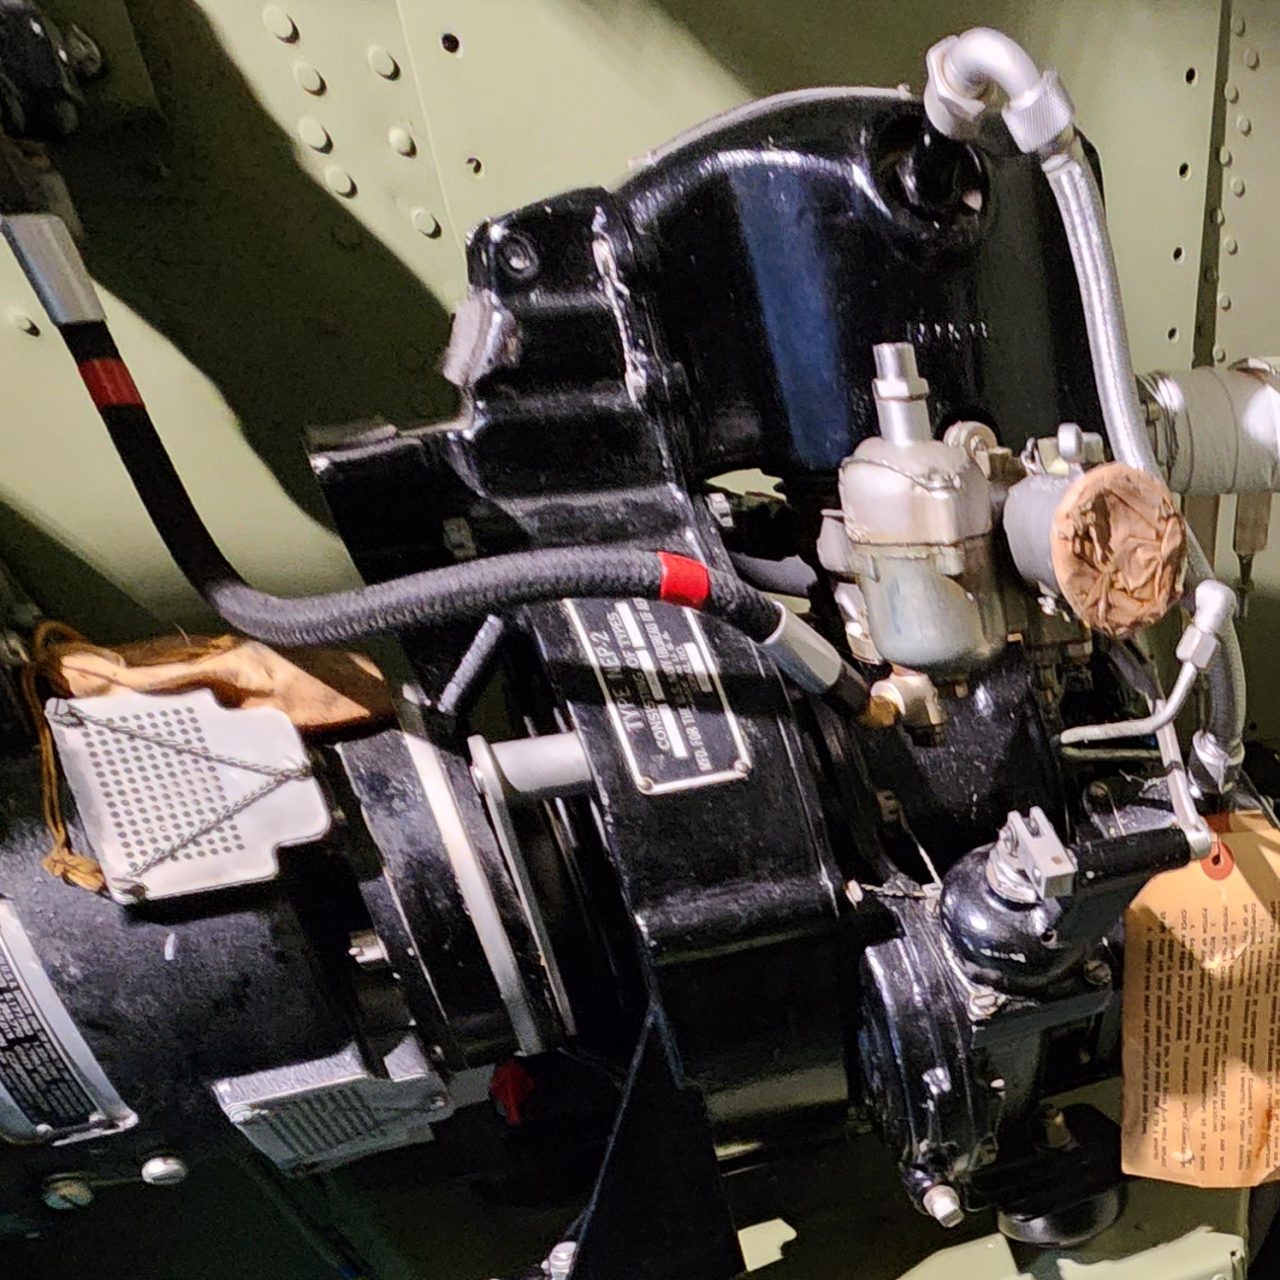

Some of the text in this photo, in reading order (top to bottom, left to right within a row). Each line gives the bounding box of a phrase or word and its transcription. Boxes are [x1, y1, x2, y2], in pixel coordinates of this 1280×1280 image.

[625, 650, 639, 669] OF
[612, 686, 644, 732] TYPE
[632, 670, 670, 750] CONSISTING
[687, 726, 703, 747] FOR
